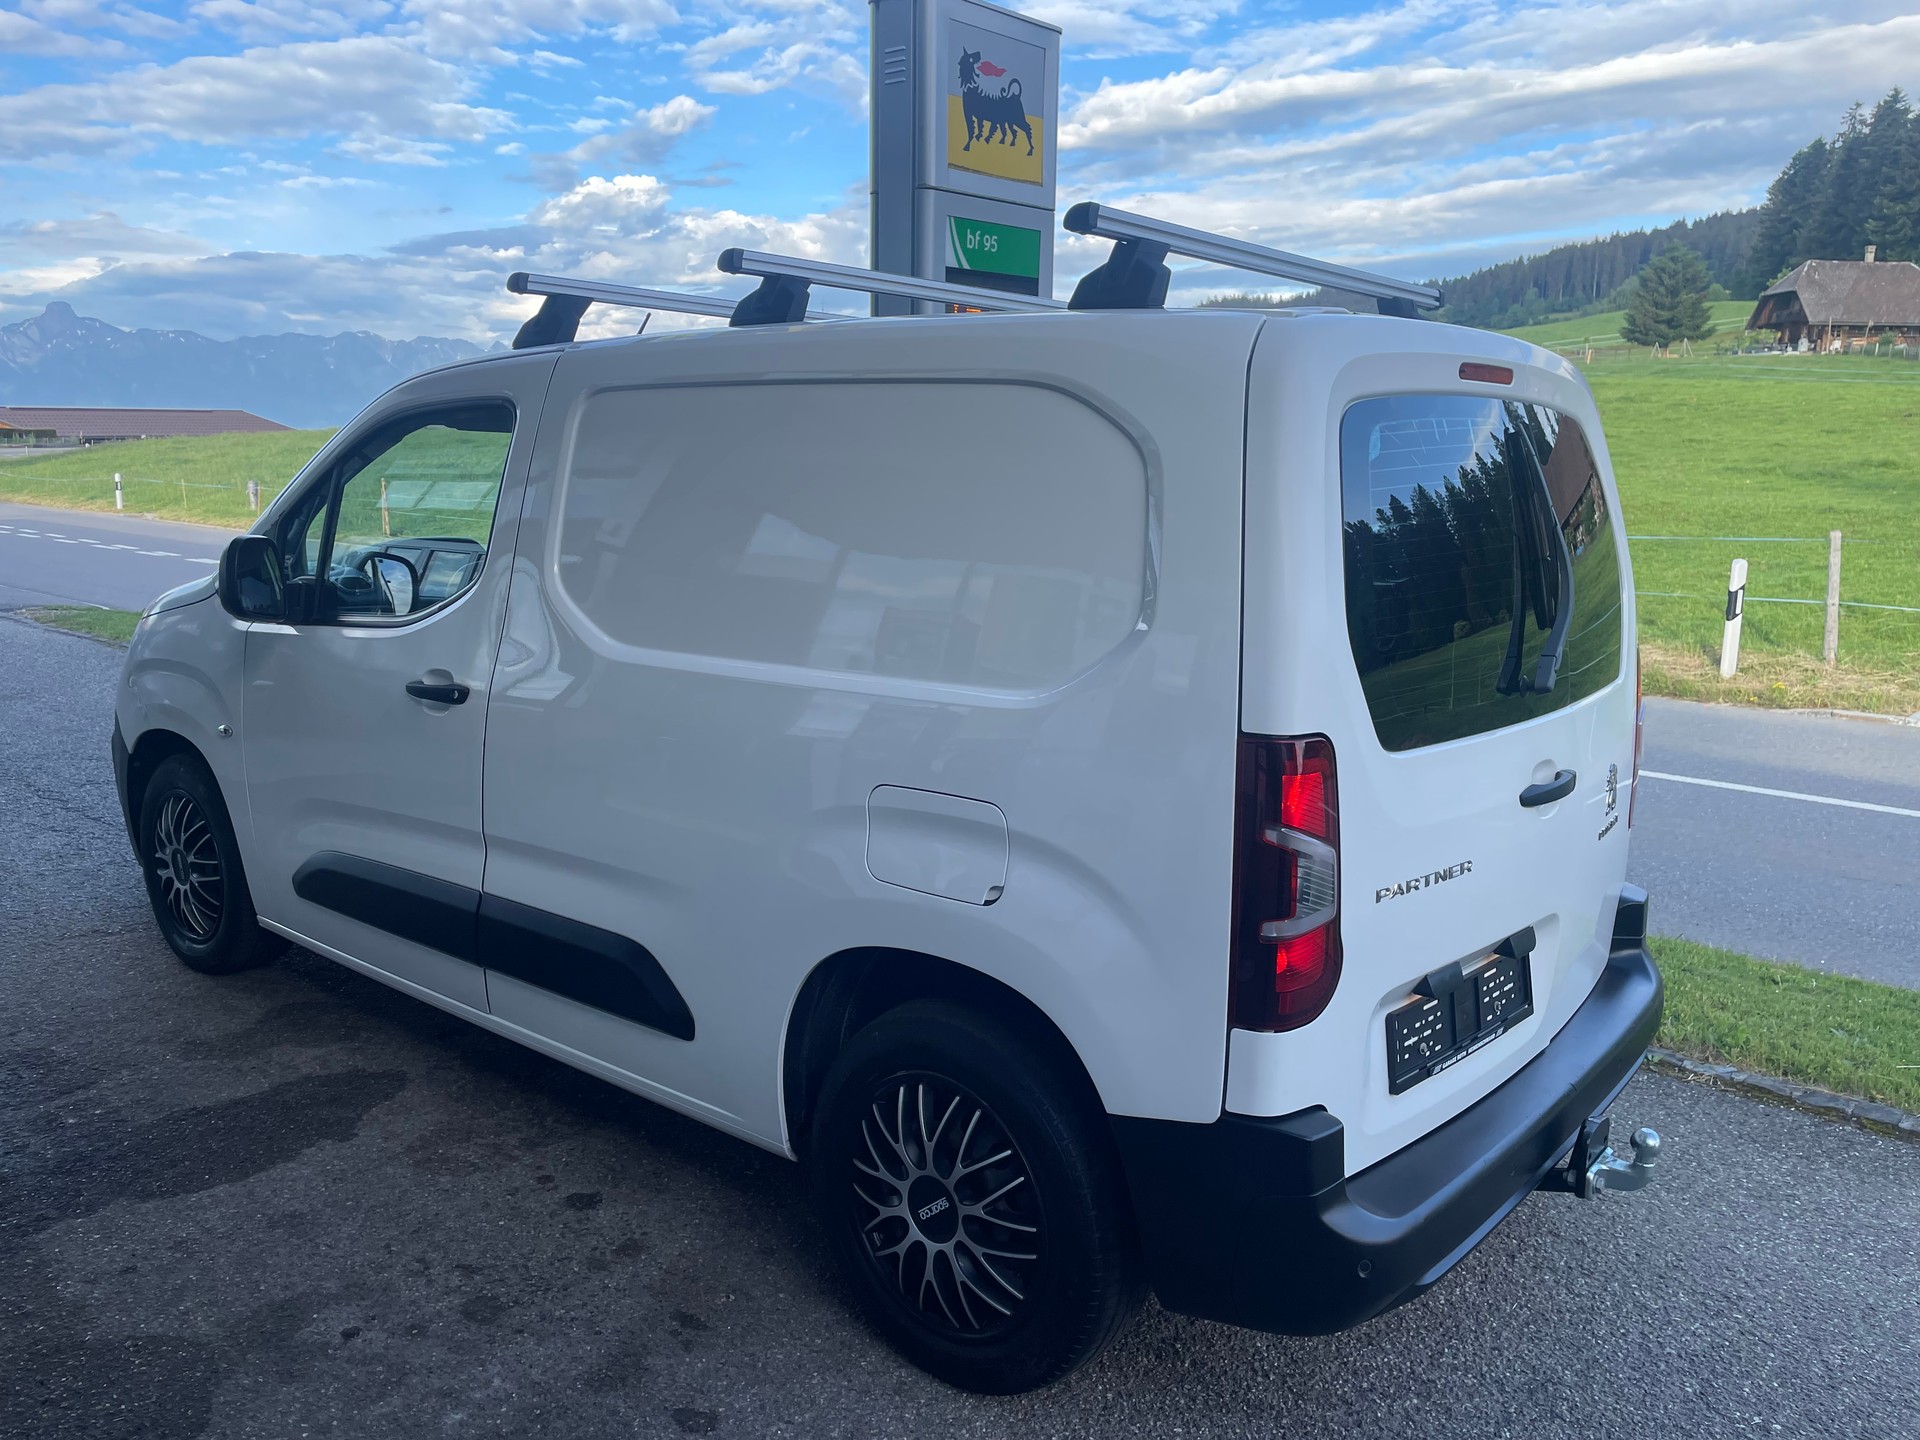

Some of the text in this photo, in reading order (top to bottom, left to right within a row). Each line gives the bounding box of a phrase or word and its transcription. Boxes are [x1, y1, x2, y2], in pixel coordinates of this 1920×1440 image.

[966, 228, 998, 252] bf 95
[1375, 860, 1473, 904] PARTNER
[919, 1198, 949, 1220] sparco
